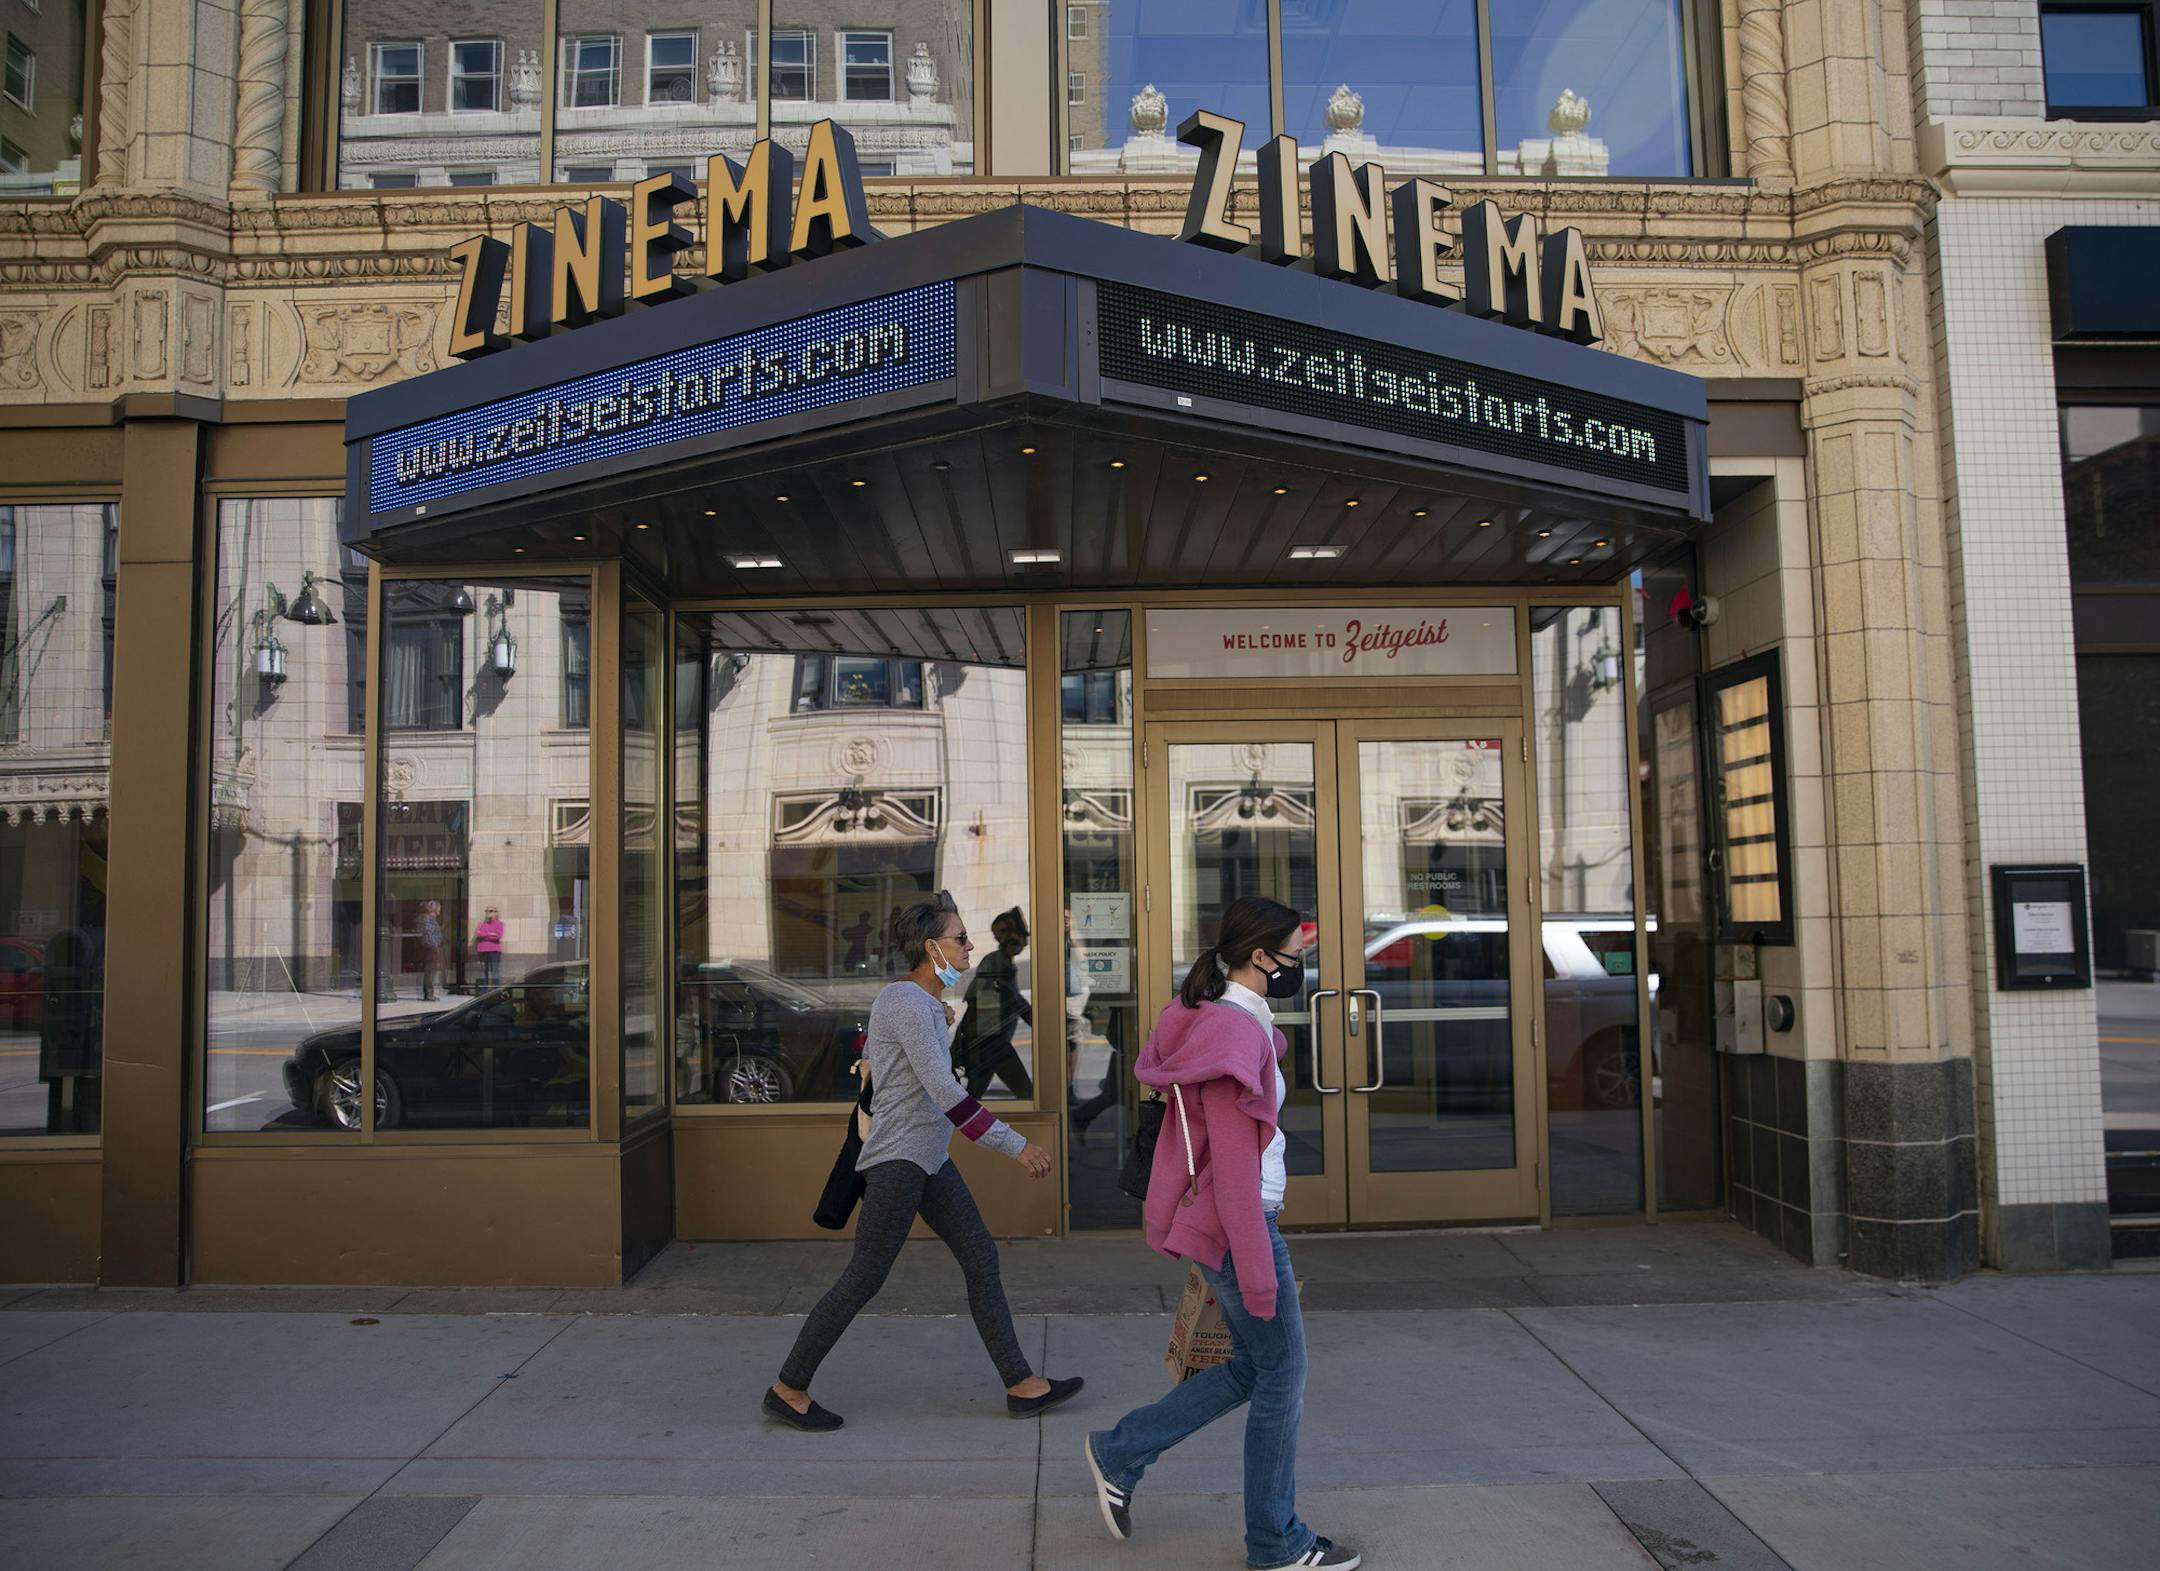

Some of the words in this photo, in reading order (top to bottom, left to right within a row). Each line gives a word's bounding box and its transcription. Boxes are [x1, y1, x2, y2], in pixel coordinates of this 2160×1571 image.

[449, 118, 868, 359] ZINEMA
[1178, 109, 1604, 343] ZINEMA
[396, 322, 909, 483] www.zeitgeistarts.com
[1139, 317, 1657, 463] www.zeitgeistarts.com
[1223, 633, 1307, 649] WELCOME
[1315, 633, 1336, 648] TO
[1343, 618, 1449, 663] Zeitgeist
[1407, 881, 1461, 890] RESTROOMS
[1410, 873, 1423, 881] NO
[1425, 872, 1457, 881] PUBLIC
